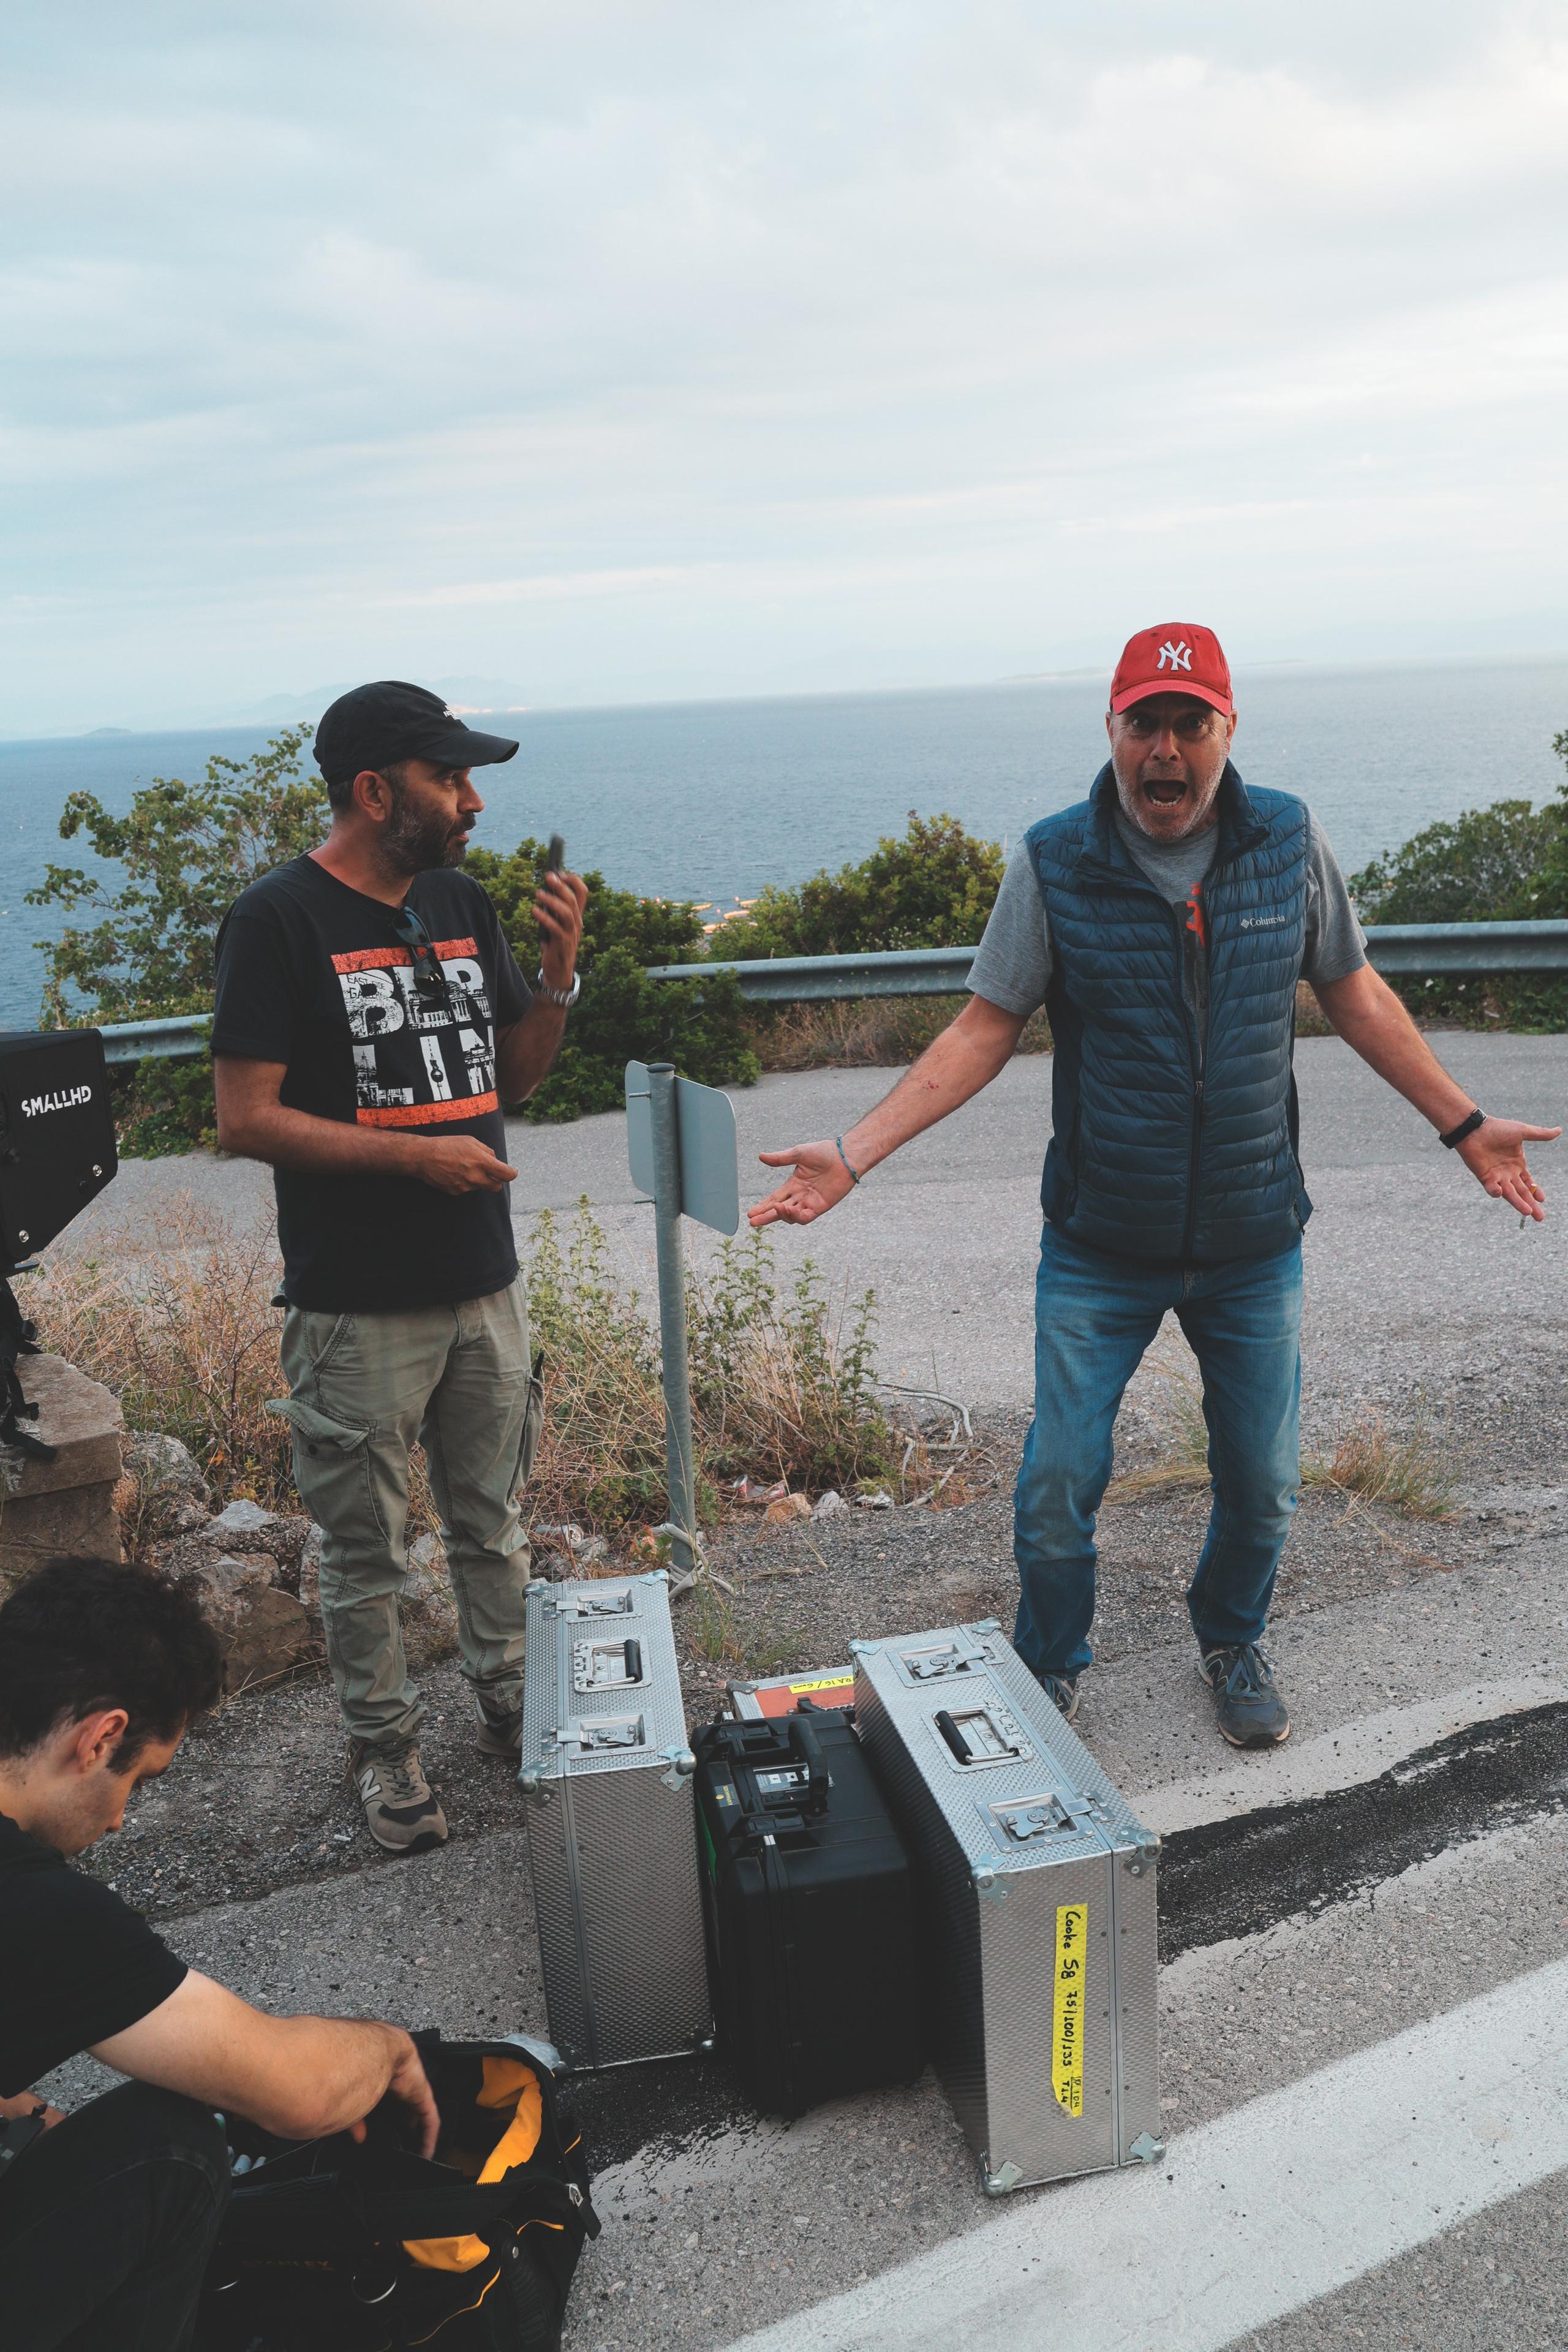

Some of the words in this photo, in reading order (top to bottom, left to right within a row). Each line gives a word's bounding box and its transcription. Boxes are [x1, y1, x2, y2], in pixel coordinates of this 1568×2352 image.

[1157, 641, 1193, 671] NY
[1250, 914, 1286, 927] Columbia
[352, 1025, 496, 1106] LIN
[21, 1085, 92, 1118] SMALLHD
[1064, 1910, 1081, 1950] Cooke
